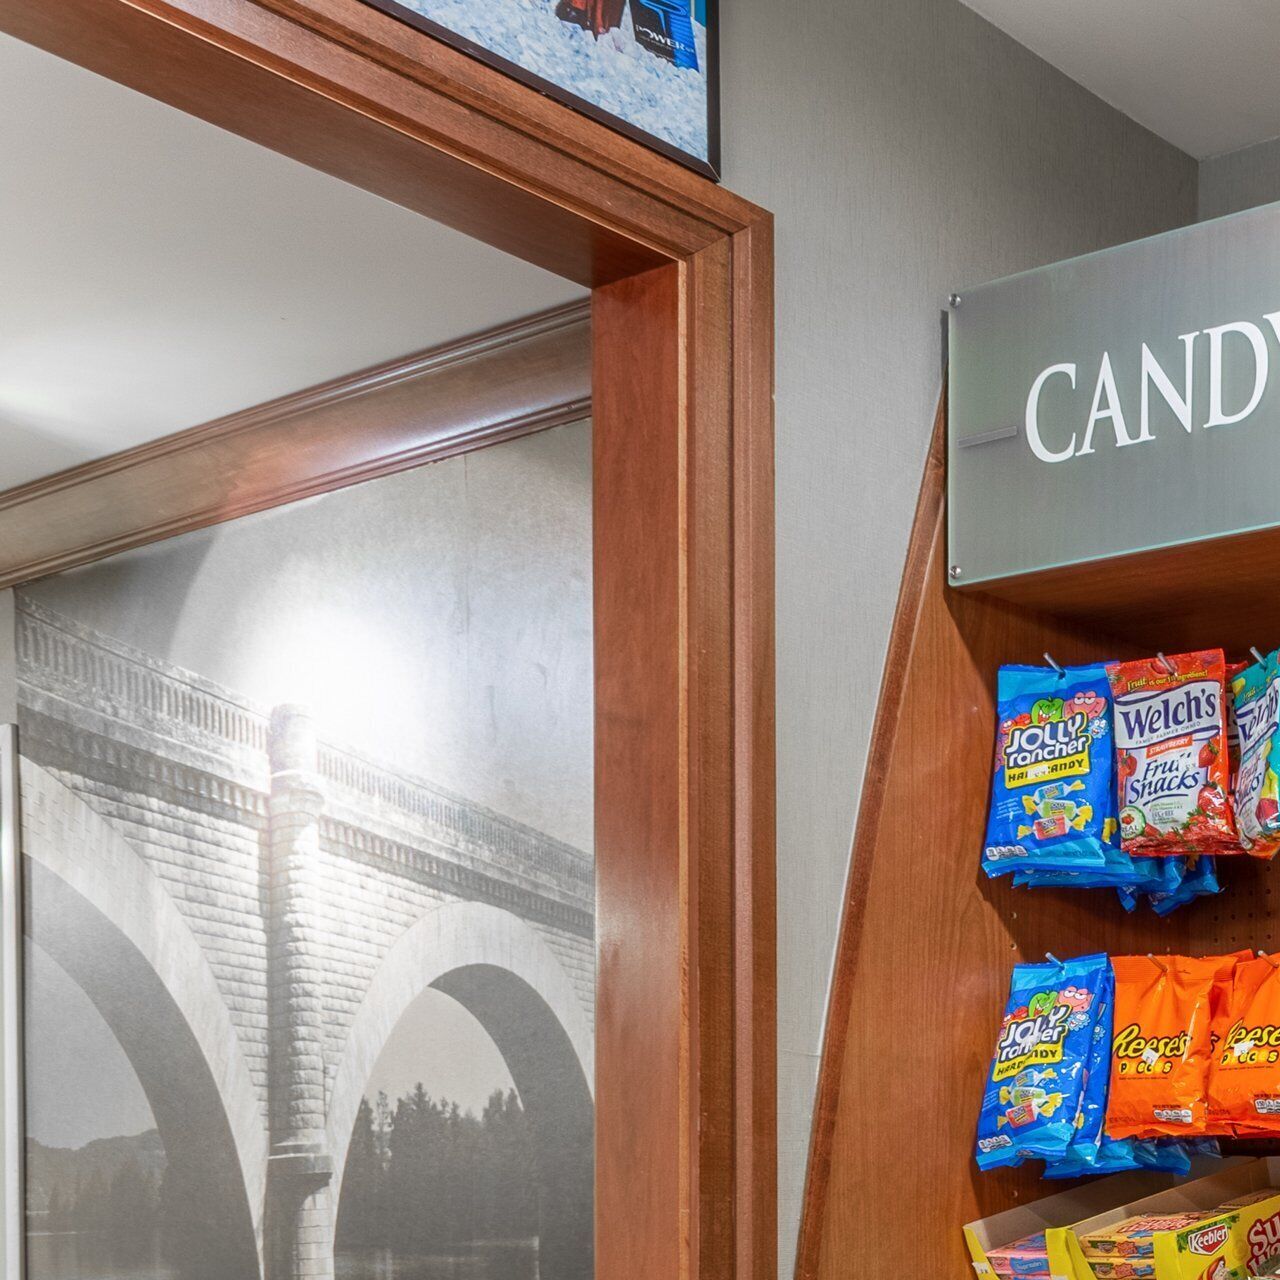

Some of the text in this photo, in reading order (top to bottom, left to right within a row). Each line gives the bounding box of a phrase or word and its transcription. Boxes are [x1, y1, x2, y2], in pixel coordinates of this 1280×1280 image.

[1120, 688, 1216, 740] Welch's
[1006, 713, 1082, 753] JOLLY
[1009, 738, 1086, 767] rancher
[1129, 771, 1199, 804] Snacks
[1113, 1023, 1192, 1057] Reese's
